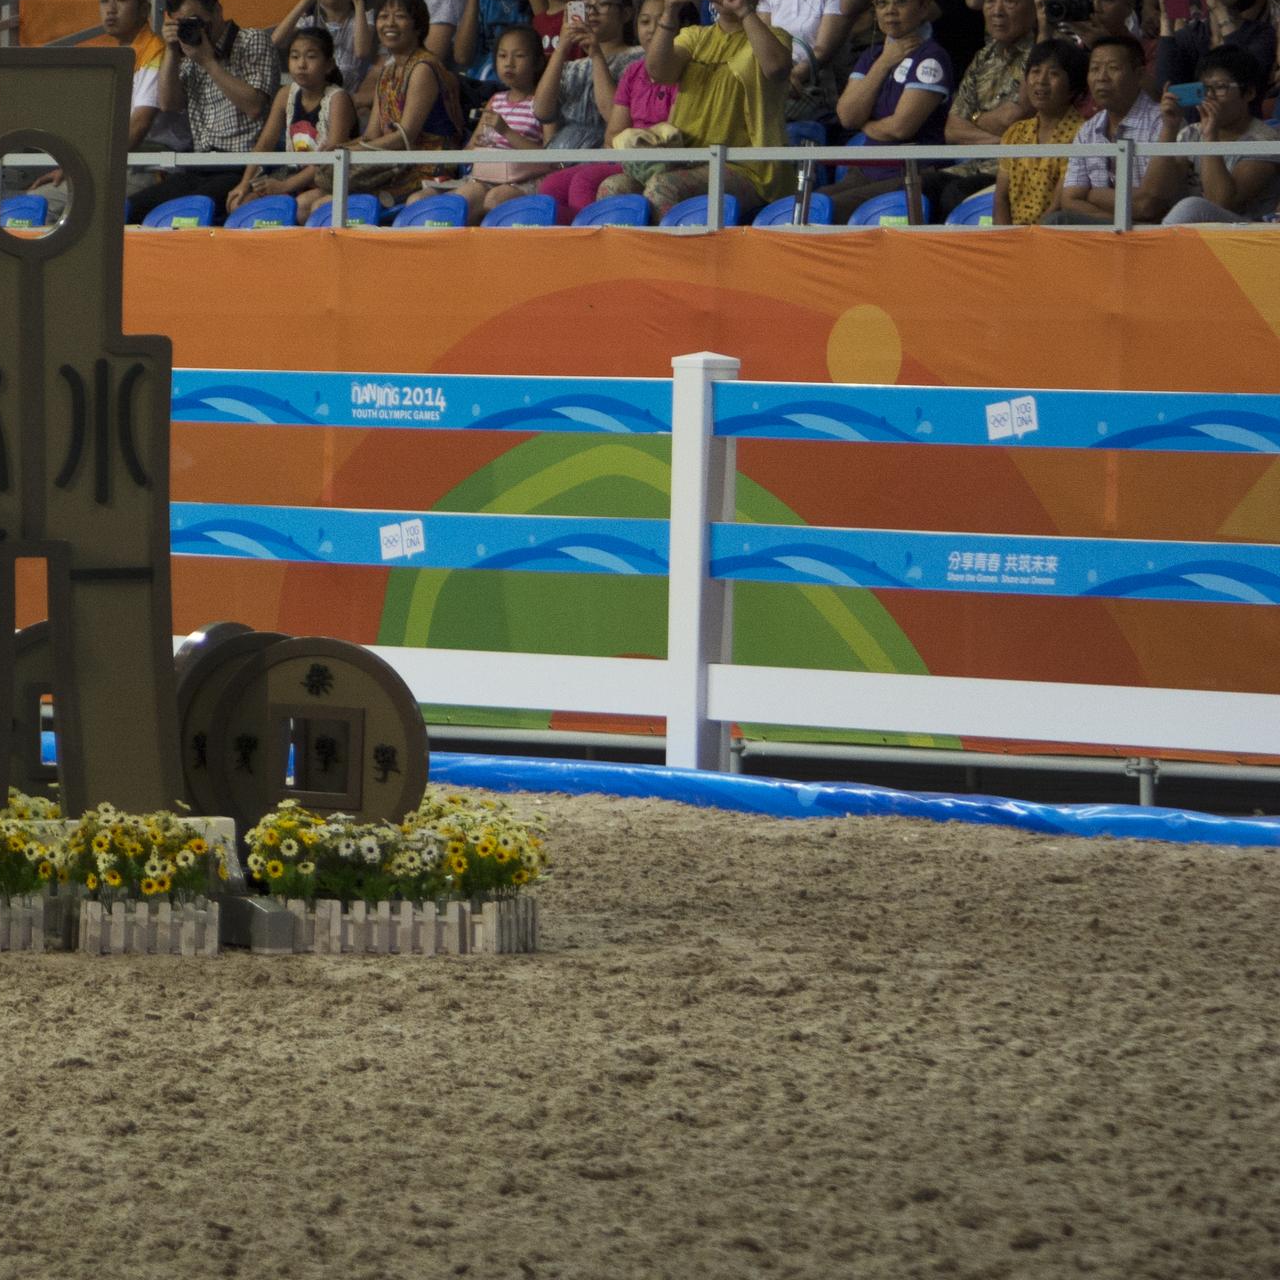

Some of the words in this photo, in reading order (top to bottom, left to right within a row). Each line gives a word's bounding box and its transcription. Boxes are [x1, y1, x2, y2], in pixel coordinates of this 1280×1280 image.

[402, 387, 446, 413] 2014
[351, 408, 377, 419] YOUTH
[379, 409, 412, 420] OLYMPIC
[413, 410, 440, 421] GAMES
